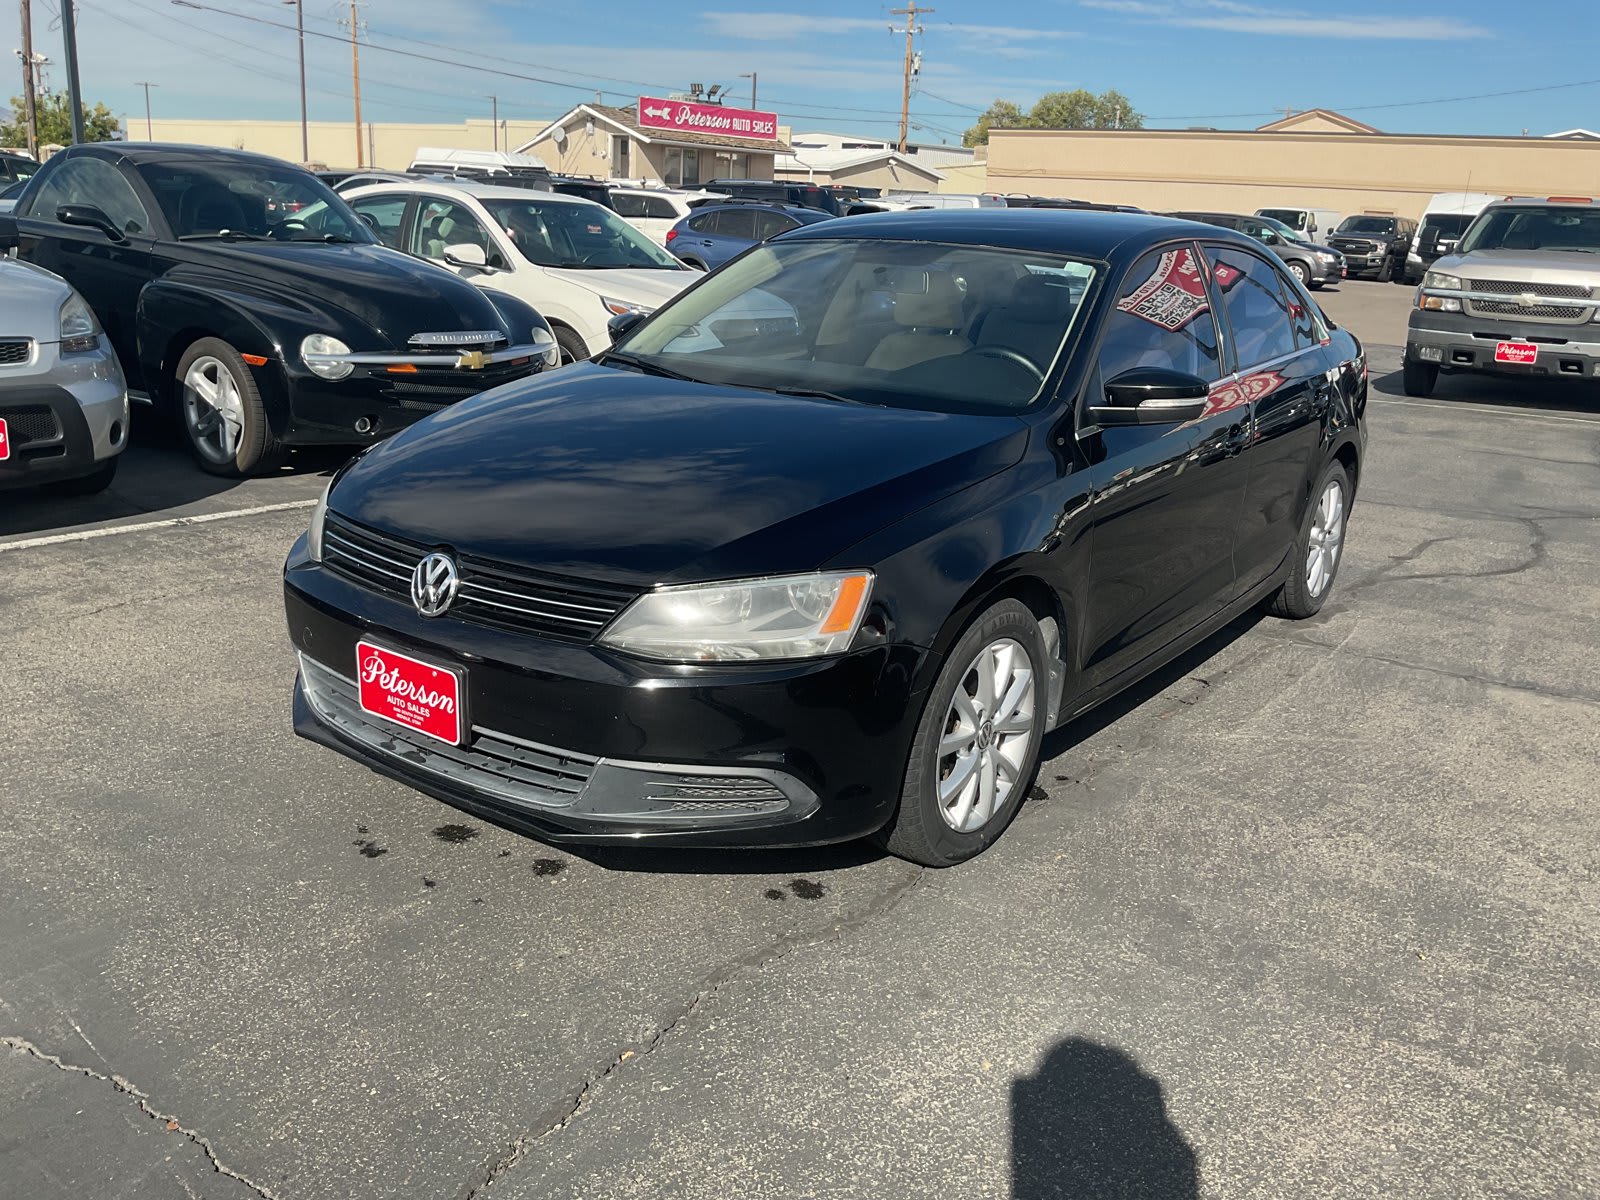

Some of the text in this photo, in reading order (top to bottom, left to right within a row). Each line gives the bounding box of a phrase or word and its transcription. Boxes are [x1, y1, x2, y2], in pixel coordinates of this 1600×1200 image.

[675, 105, 774, 134] Peterson AUTO SALES
[1498, 344, 1535, 356] Peterson
[362, 656, 454, 714] Peterson
[387, 695, 406, 708] AUTO
[407, 702, 430, 718] SALES
